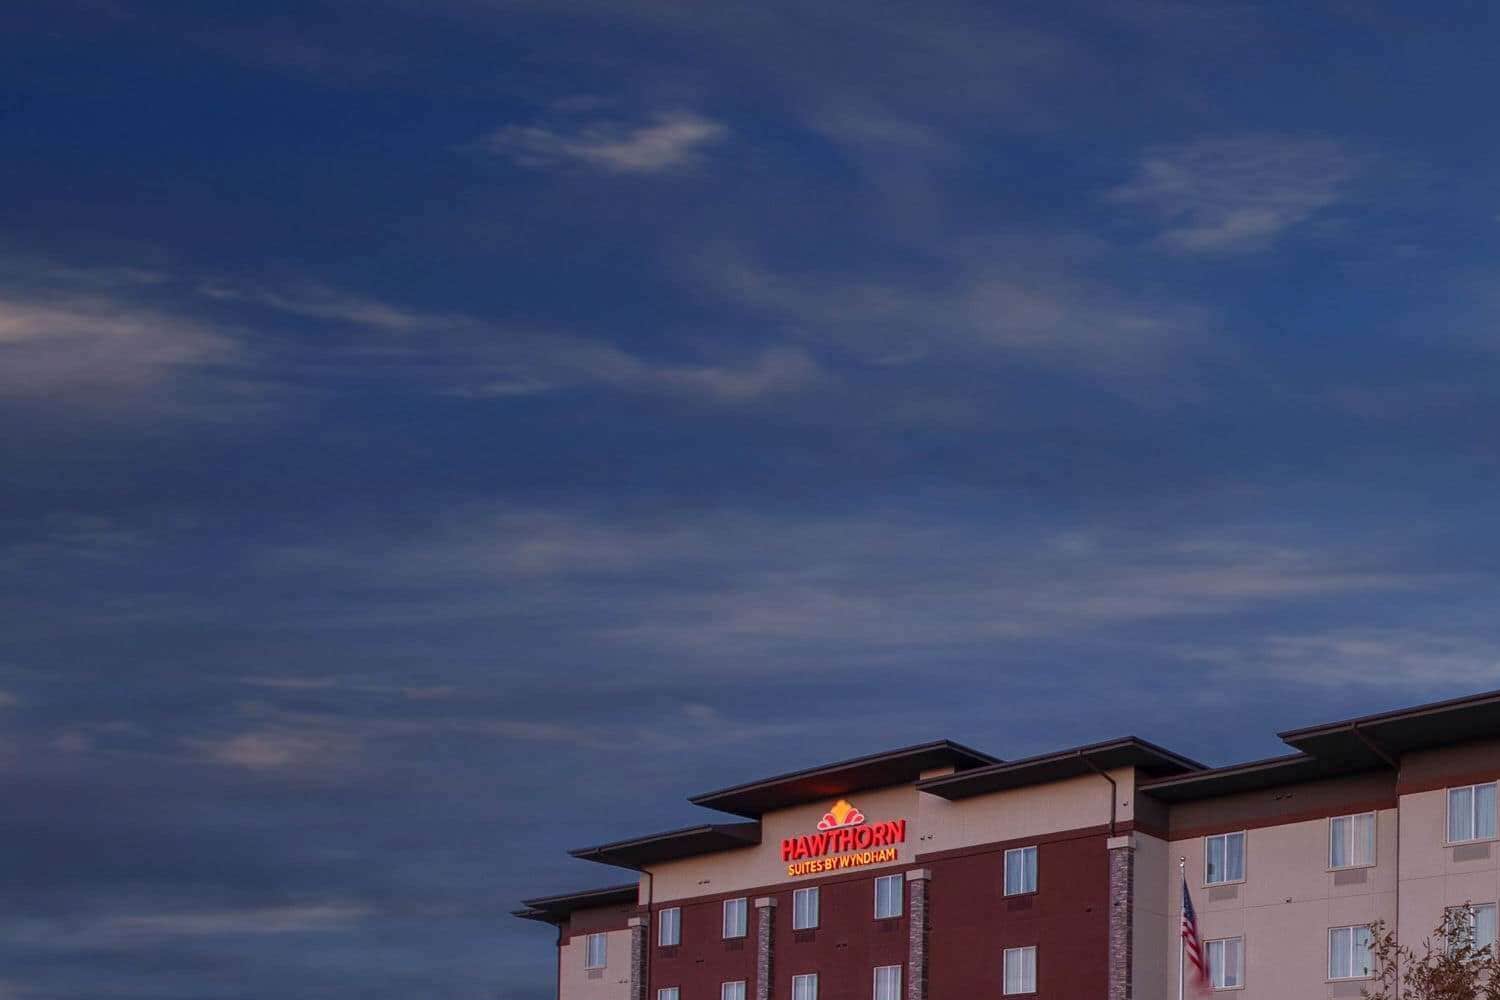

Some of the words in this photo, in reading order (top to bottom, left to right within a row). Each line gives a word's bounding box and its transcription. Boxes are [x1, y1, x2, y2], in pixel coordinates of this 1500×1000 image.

[781, 819, 905, 861] HAWTHORN
[788, 860, 823, 876] SUITES
[825, 857, 838, 870] BY
[840, 848, 897, 867] WYNDHAM
